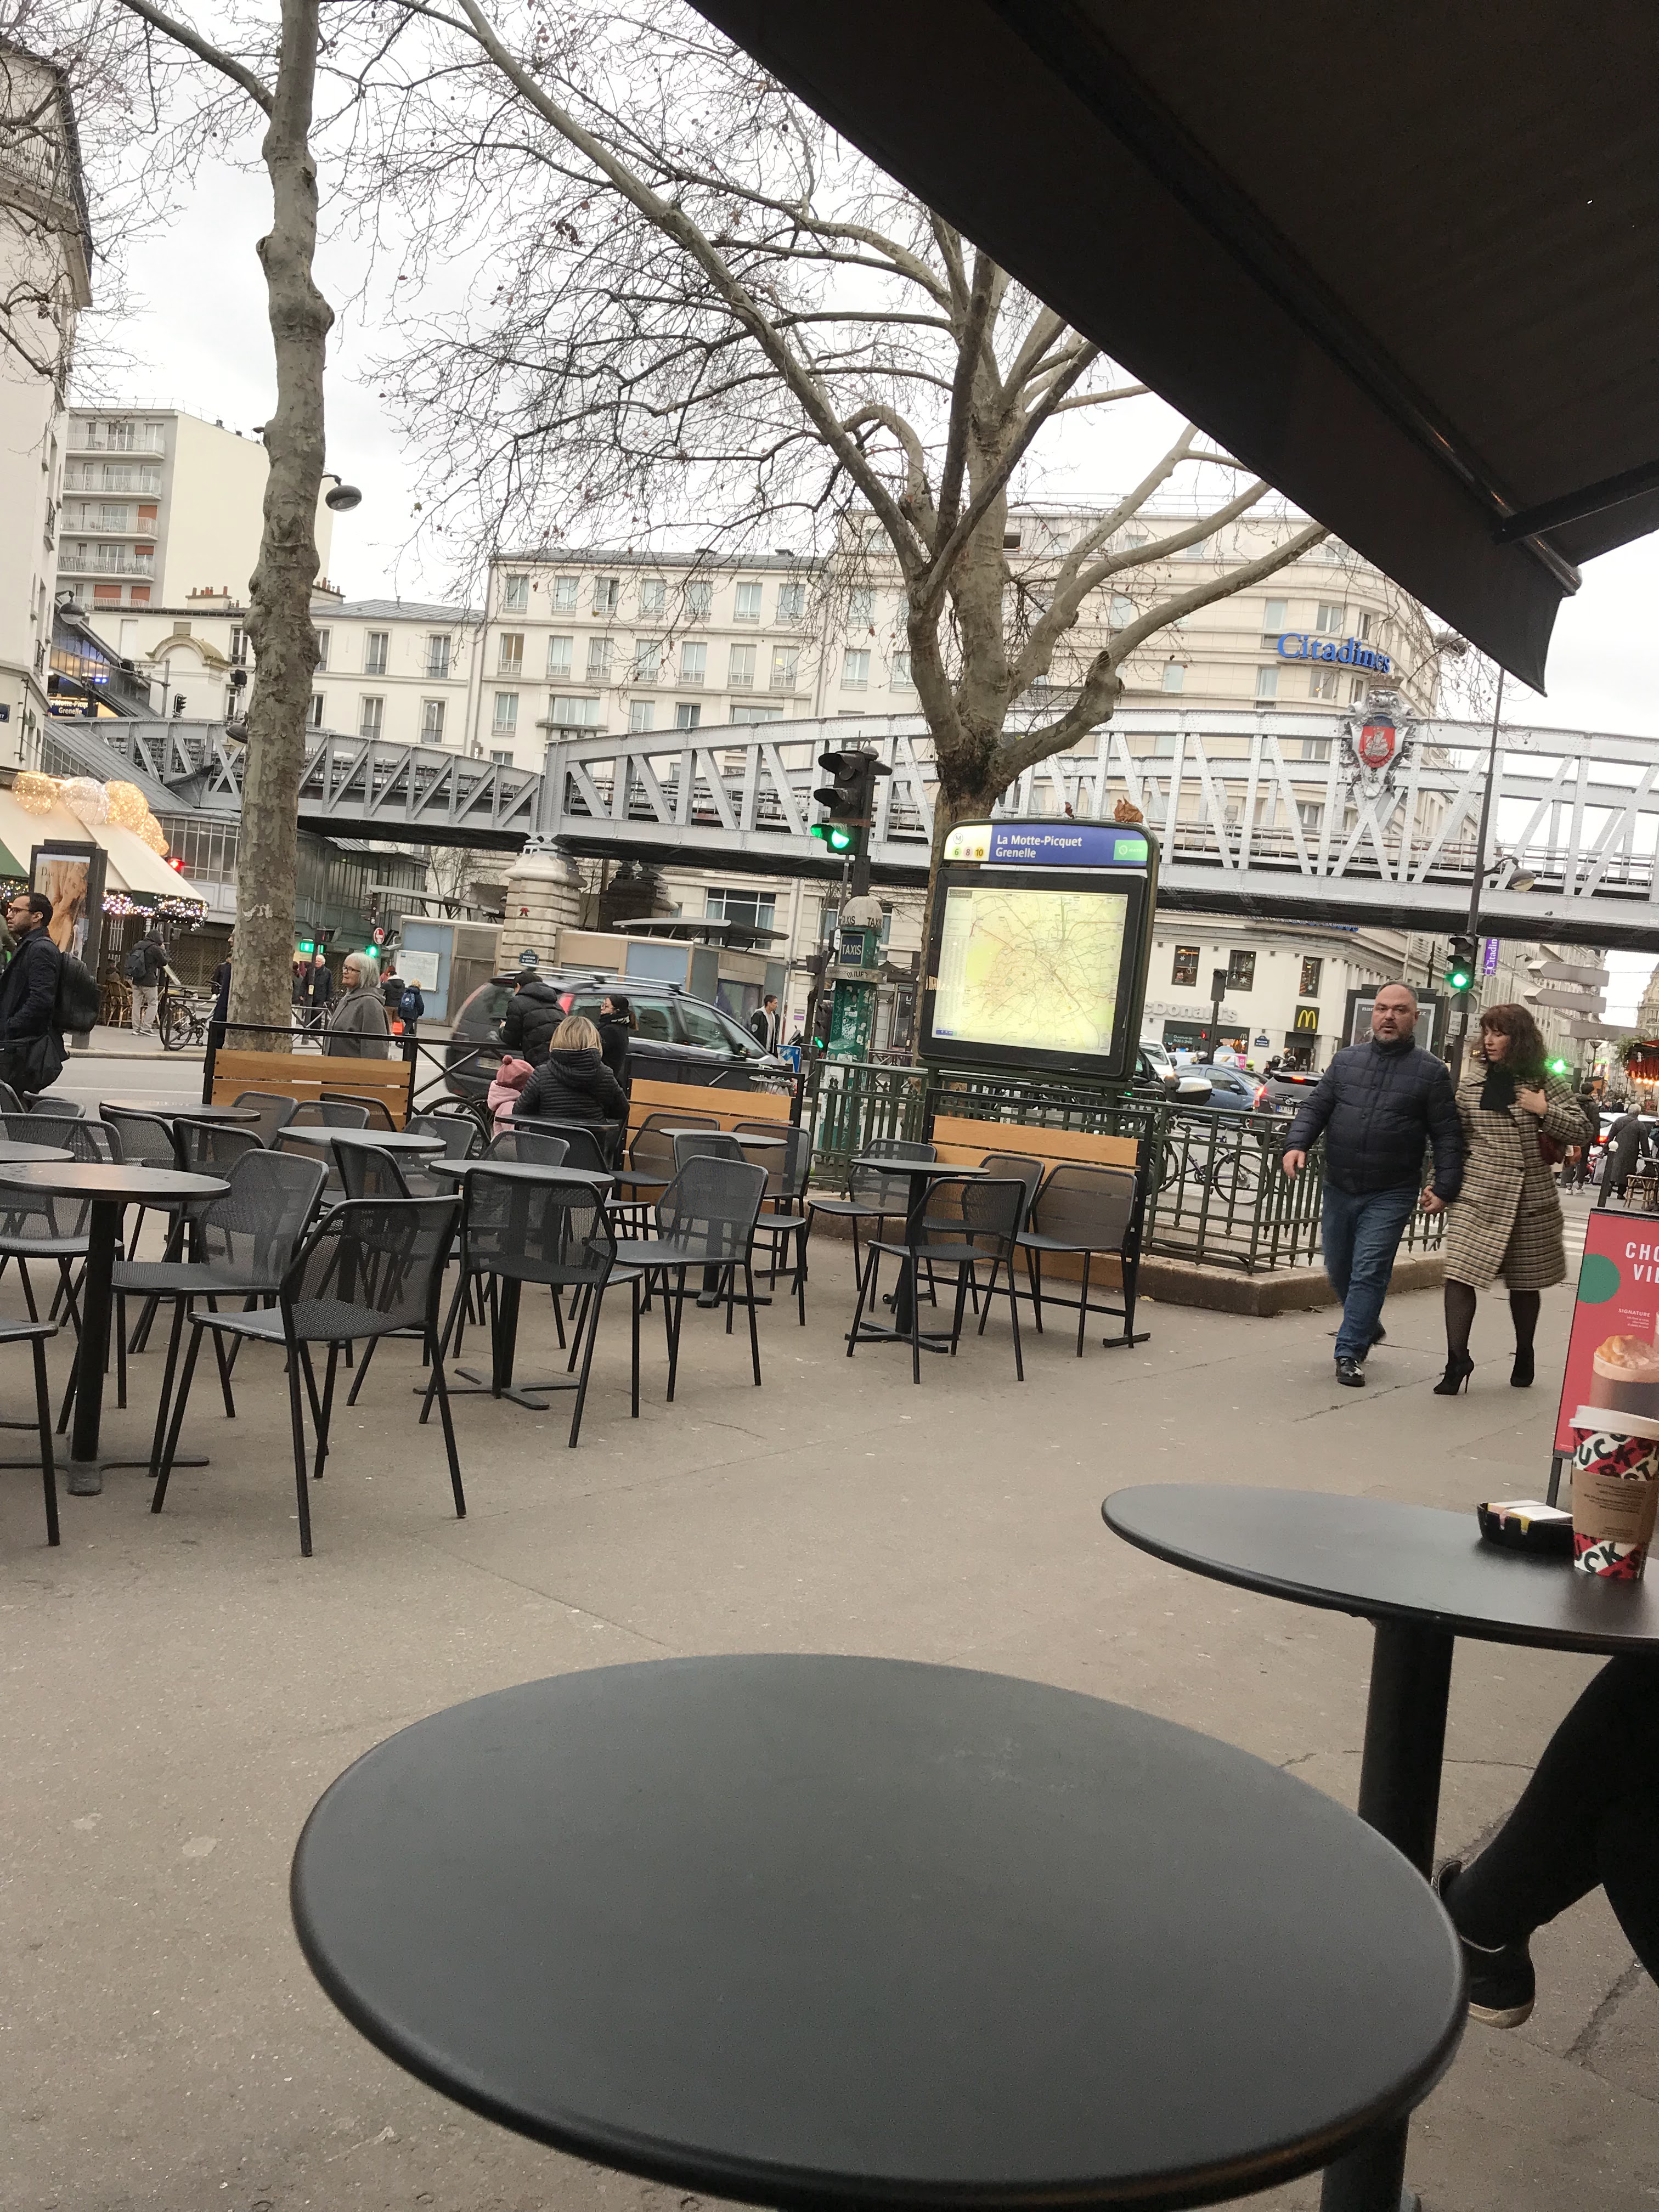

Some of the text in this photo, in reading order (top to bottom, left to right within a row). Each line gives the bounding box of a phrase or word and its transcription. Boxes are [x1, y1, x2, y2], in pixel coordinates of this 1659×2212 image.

[1277, 633, 1391, 673] Citadines
[997, 834, 1082, 848] La Motte-Picquet
[975, 848, 984, 856] 10
[996, 848, 1036, 858] Grenelle
[842, 944, 862, 956] TAXIS
[1618, 1308, 1651, 1317] SIGNATURE
